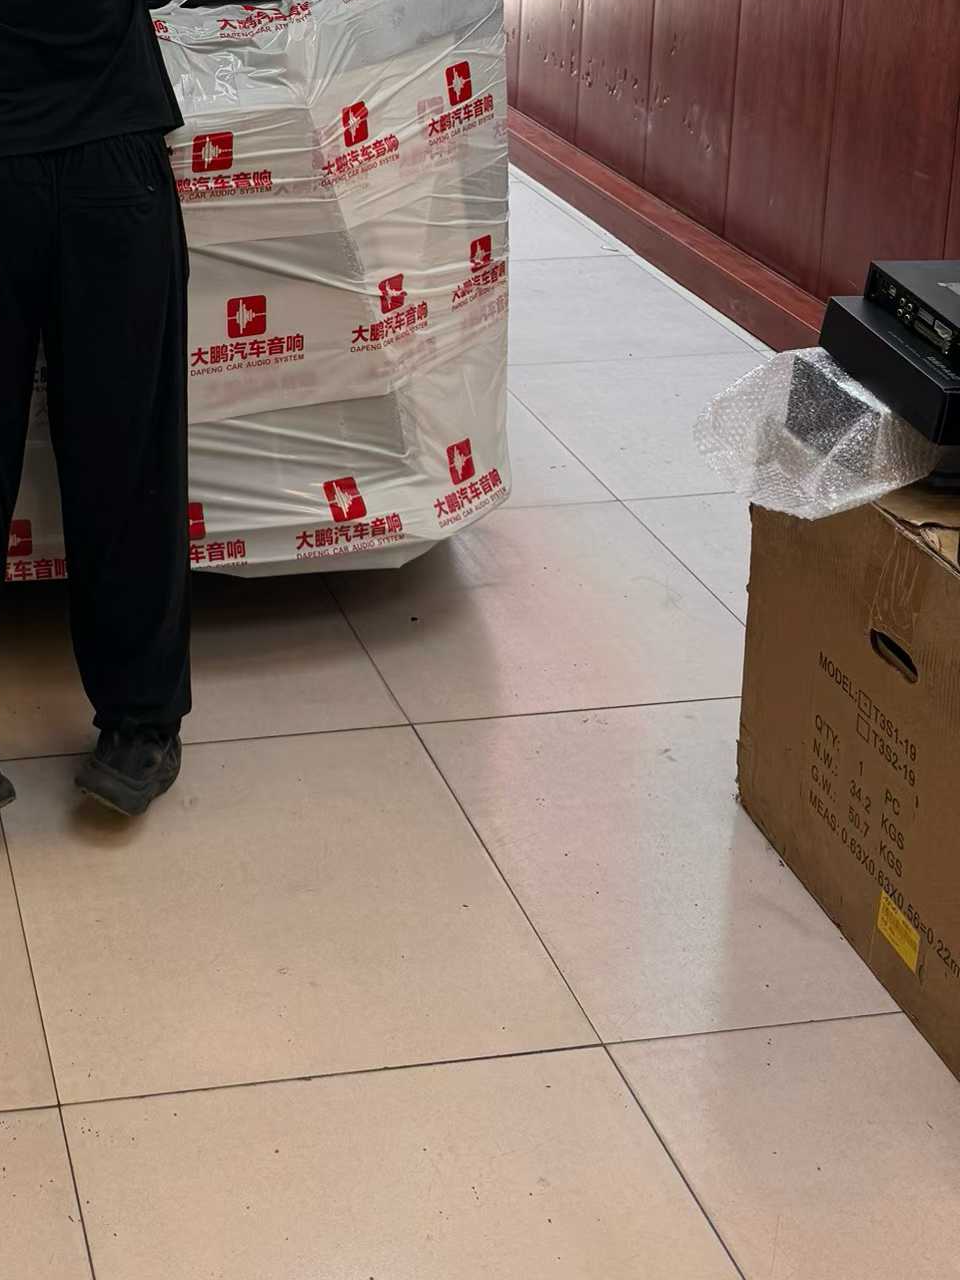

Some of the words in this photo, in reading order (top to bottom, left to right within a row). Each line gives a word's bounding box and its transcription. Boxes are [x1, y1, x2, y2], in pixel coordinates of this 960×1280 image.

[428, 94, 494, 137] 大鹏汽车音响
[322, 134, 400, 177] 大鹏汽车音响
[190, 190, 206, 200] CAR
[210, 189, 237, 199] AUDIO
[240, 185, 273, 195] SYSTEM
[352, 301, 429, 344] 大鹏汽车音响
[190, 366, 223, 377] DAPENG
[226, 363, 243, 372] CAR
[246, 358, 271, 368] AUDIO
[274, 354, 305, 365] SYSTEM
[191, 334, 304, 367] 大鹏汽车音响
[350, 344, 382, 353] DAPENG
[433, 468, 502, 519] 大鹏汽车音响
[296, 512, 403, 550] 大鹏汽车音响
[296, 548, 330, 561] DAPENG
[333, 545, 350, 555] CAR
[353, 540, 376, 553] AUDIO
[378, 533, 406, 547] SYSTEM
[818, 651, 858, 702] MODEL:
[809, 790, 839, 837] MEAS:
[885, 789, 900, 816] PC
[881, 813, 905, 851] KGS
[879, 840, 903, 878] KGS
